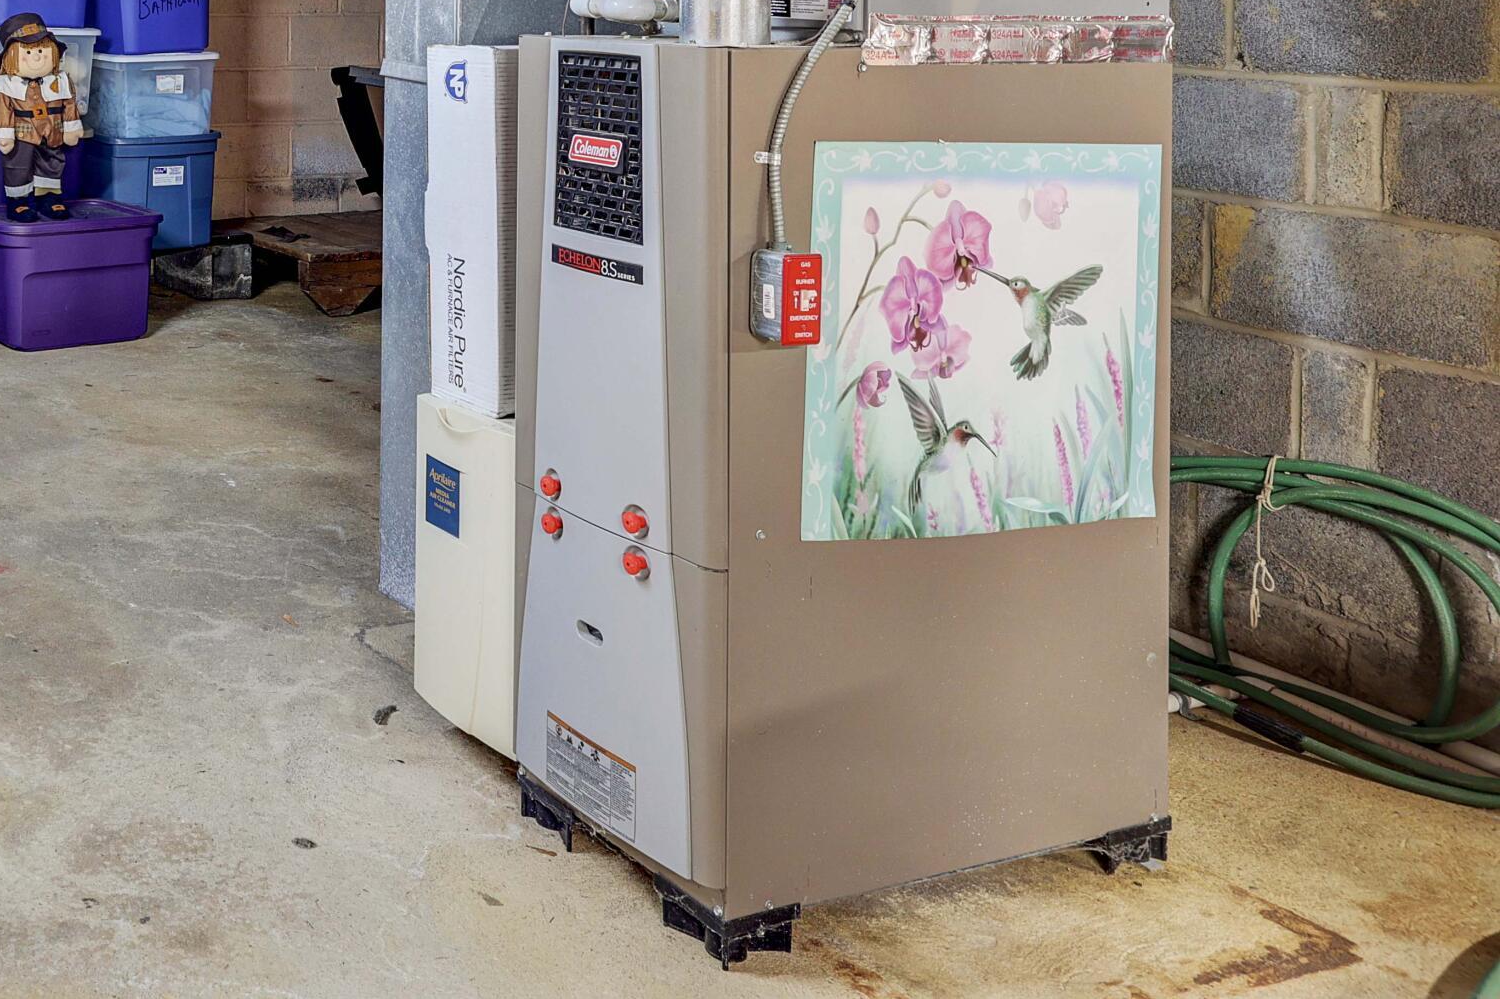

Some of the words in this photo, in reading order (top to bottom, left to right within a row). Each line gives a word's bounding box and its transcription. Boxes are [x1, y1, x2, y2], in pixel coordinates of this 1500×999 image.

[449, 68, 464, 98] NP
[574, 139, 610, 158] Coleman
[447, 253, 453, 268] AC
[558, 247, 601, 270] ECHELON
[617, 272, 636, 282] SERIES
[453, 257, 466, 330] Nordic
[454, 334, 467, 388] Pure
[429, 467, 456, 489] Aprilaire
